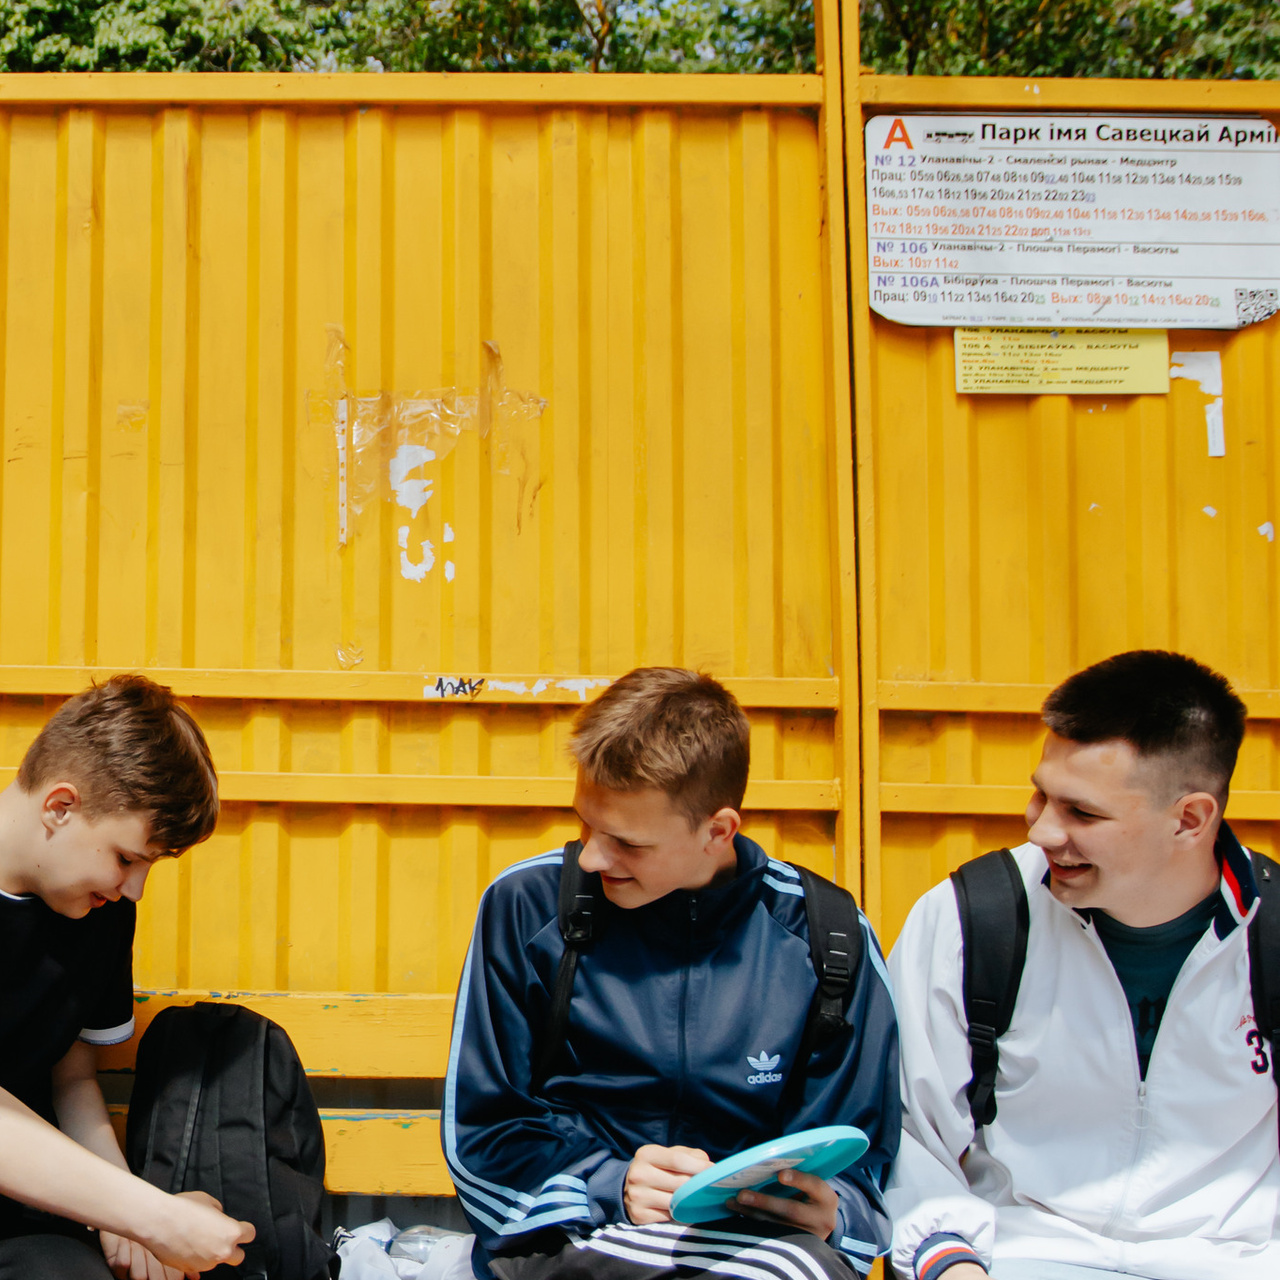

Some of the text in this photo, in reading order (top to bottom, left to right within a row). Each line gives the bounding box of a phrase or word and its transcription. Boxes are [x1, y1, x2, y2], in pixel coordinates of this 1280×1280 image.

[981, 123, 1041, 145] Парк
[1049, 123, 1087, 141] імя
[1096, 123, 1210, 144] Савецкай
[875, 155, 892, 167] №
[898, 156, 916, 167] 12
[871, 170, 906, 182] Прац:
[872, 204, 903, 216] Вых:
[876, 242, 893, 254] №
[900, 242, 928, 254] 106
[873, 256, 904, 268] Вых:
[877, 276, 895, 288] №
[873, 290, 909, 303] Прац:
[1051, 293, 1083, 305] Вых:
[1245, 1029, 1269, 1075] 3
[747, 1072, 783, 1085] adidas
